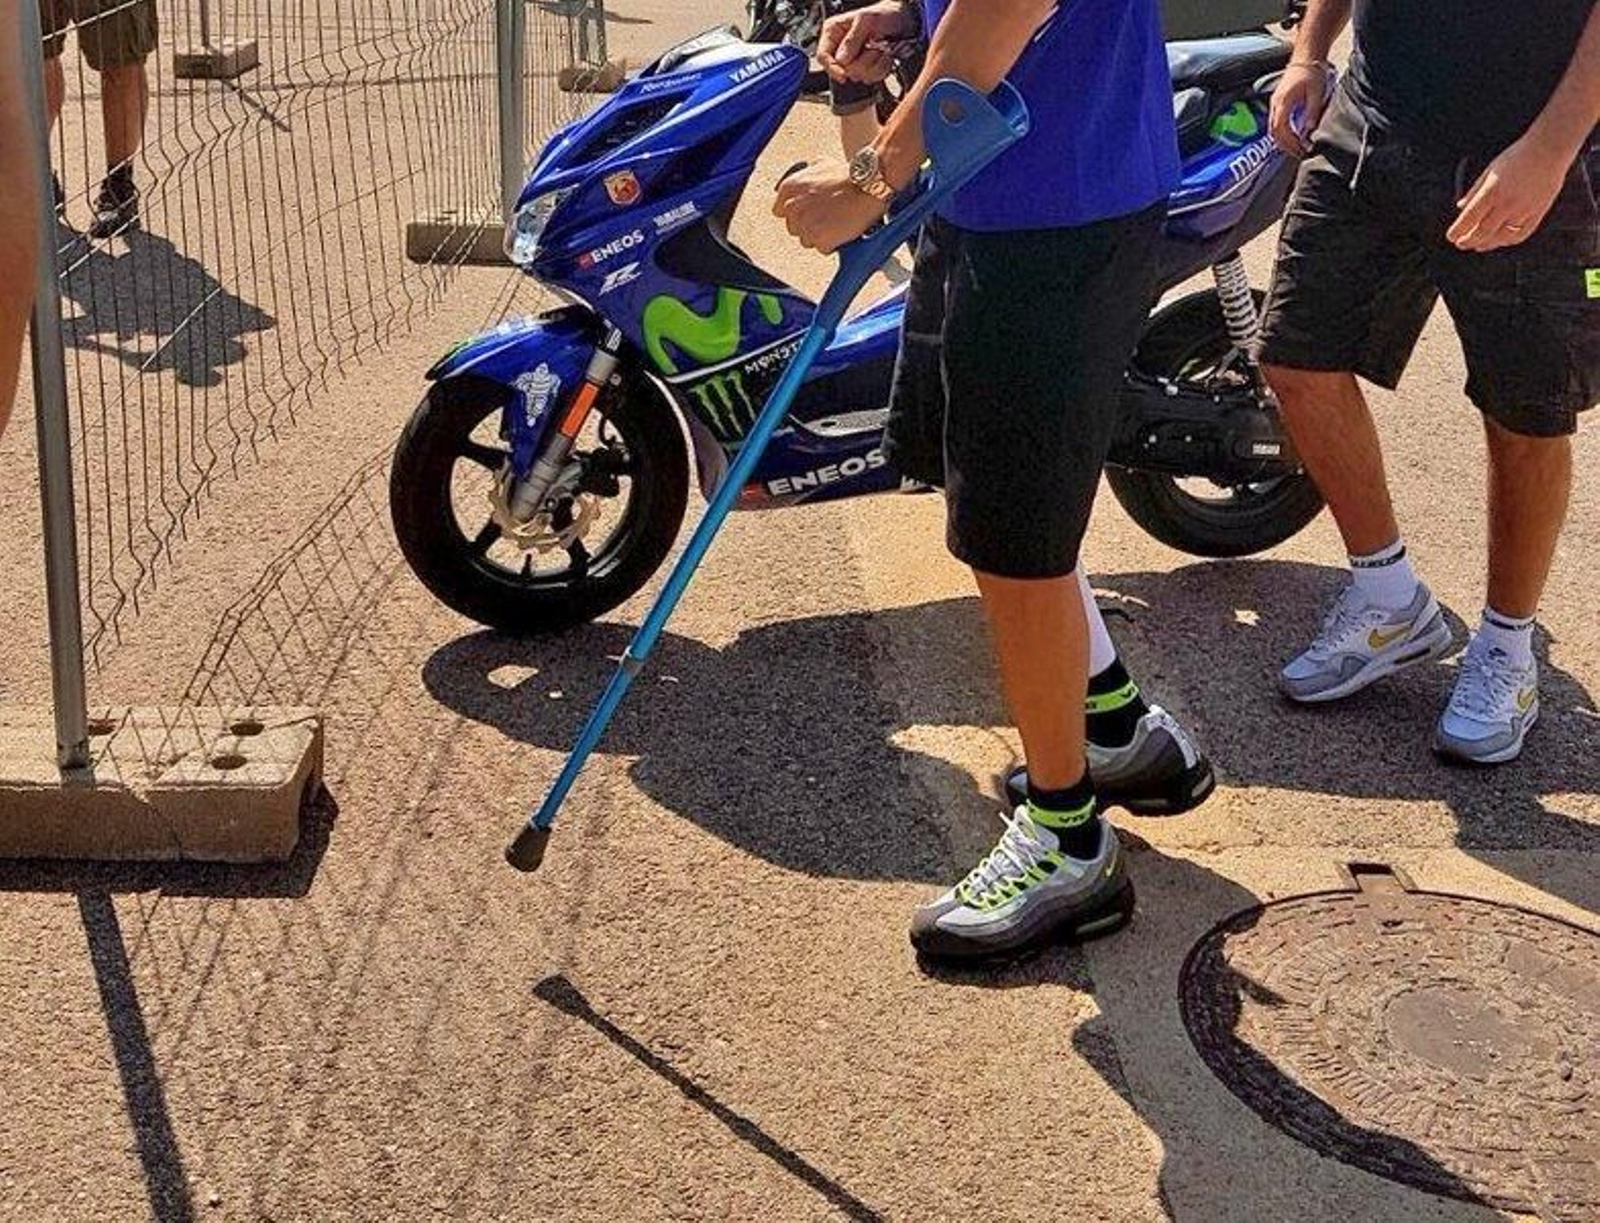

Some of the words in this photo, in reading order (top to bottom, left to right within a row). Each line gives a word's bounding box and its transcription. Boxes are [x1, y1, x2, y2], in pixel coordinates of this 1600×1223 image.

[729, 49, 786, 83] YAMAHA
[590, 229, 645, 264] ENEOS
[744, 338, 805, 375] MONST
[767, 447, 887, 497] ENEOS
